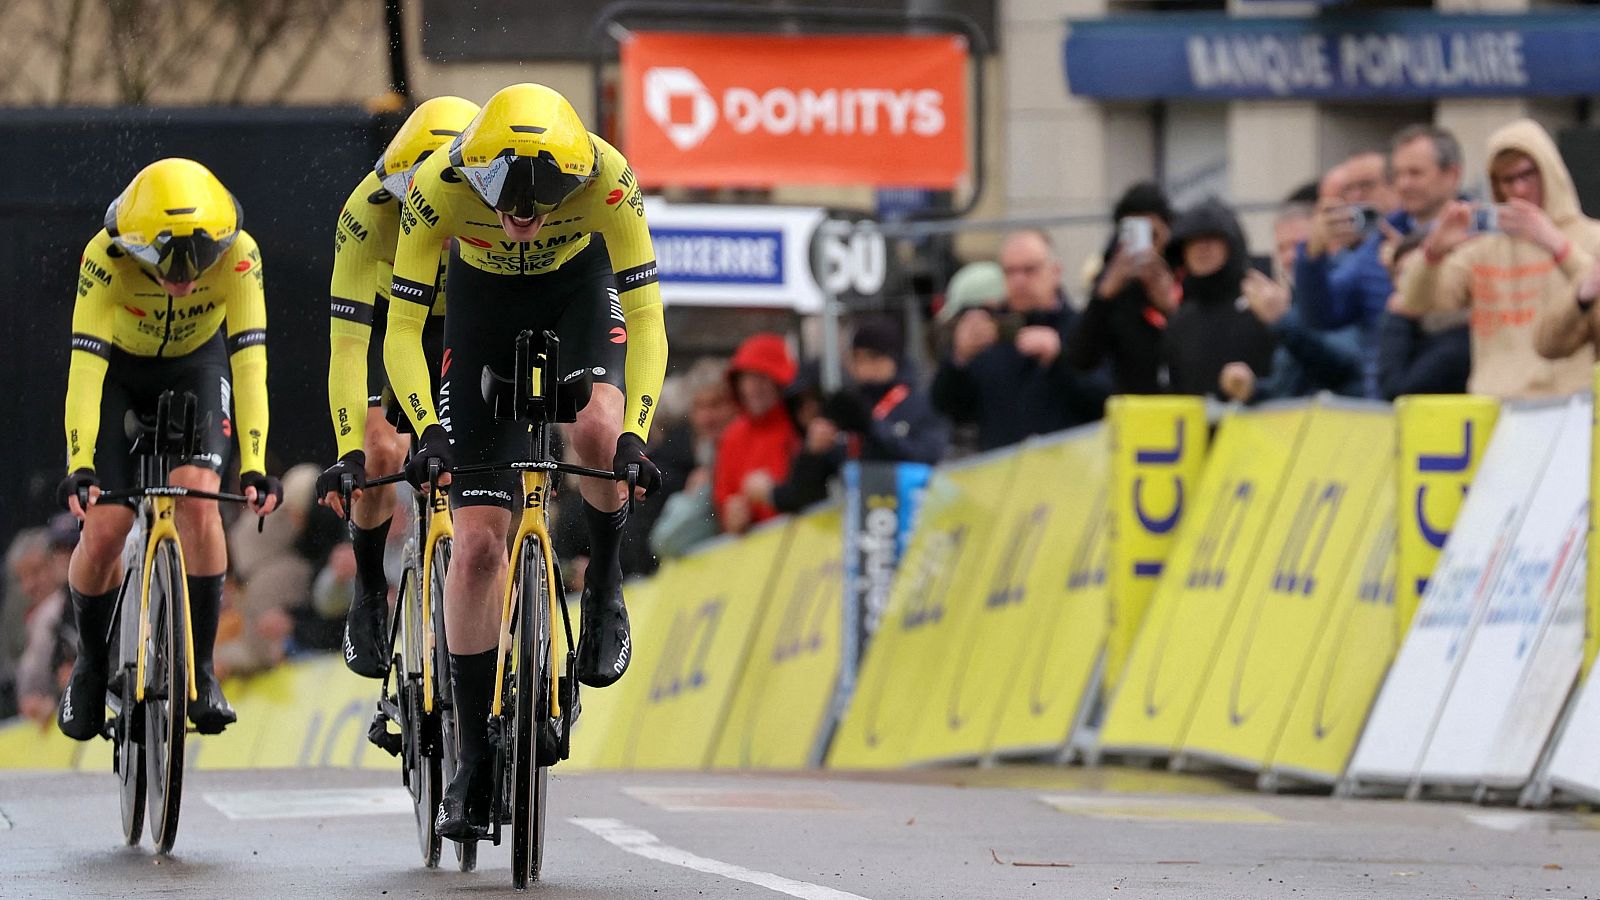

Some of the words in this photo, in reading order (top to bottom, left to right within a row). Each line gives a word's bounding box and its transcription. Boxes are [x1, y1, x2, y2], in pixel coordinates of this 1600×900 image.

[1187, 33, 1333, 95] BANQUE
[1340, 30, 1529, 87] POPULAIRE
[723, 86, 946, 136] DOMITYS
[410, 186, 440, 226] VISMA
[342, 208, 368, 242] VISMA
[499, 231, 583, 252] VISMA
[655, 236, 779, 279] UXERRE
[85, 258, 112, 286] VISMA
[154, 301, 215, 321] VISMA
[407, 393, 423, 414] AGU
[637, 403, 650, 428] AGU
[337, 407, 348, 429] AGU
[511, 461, 558, 470] cervélo
[462, 488, 512, 501] cervélo
[1416, 420, 1473, 596] CL
